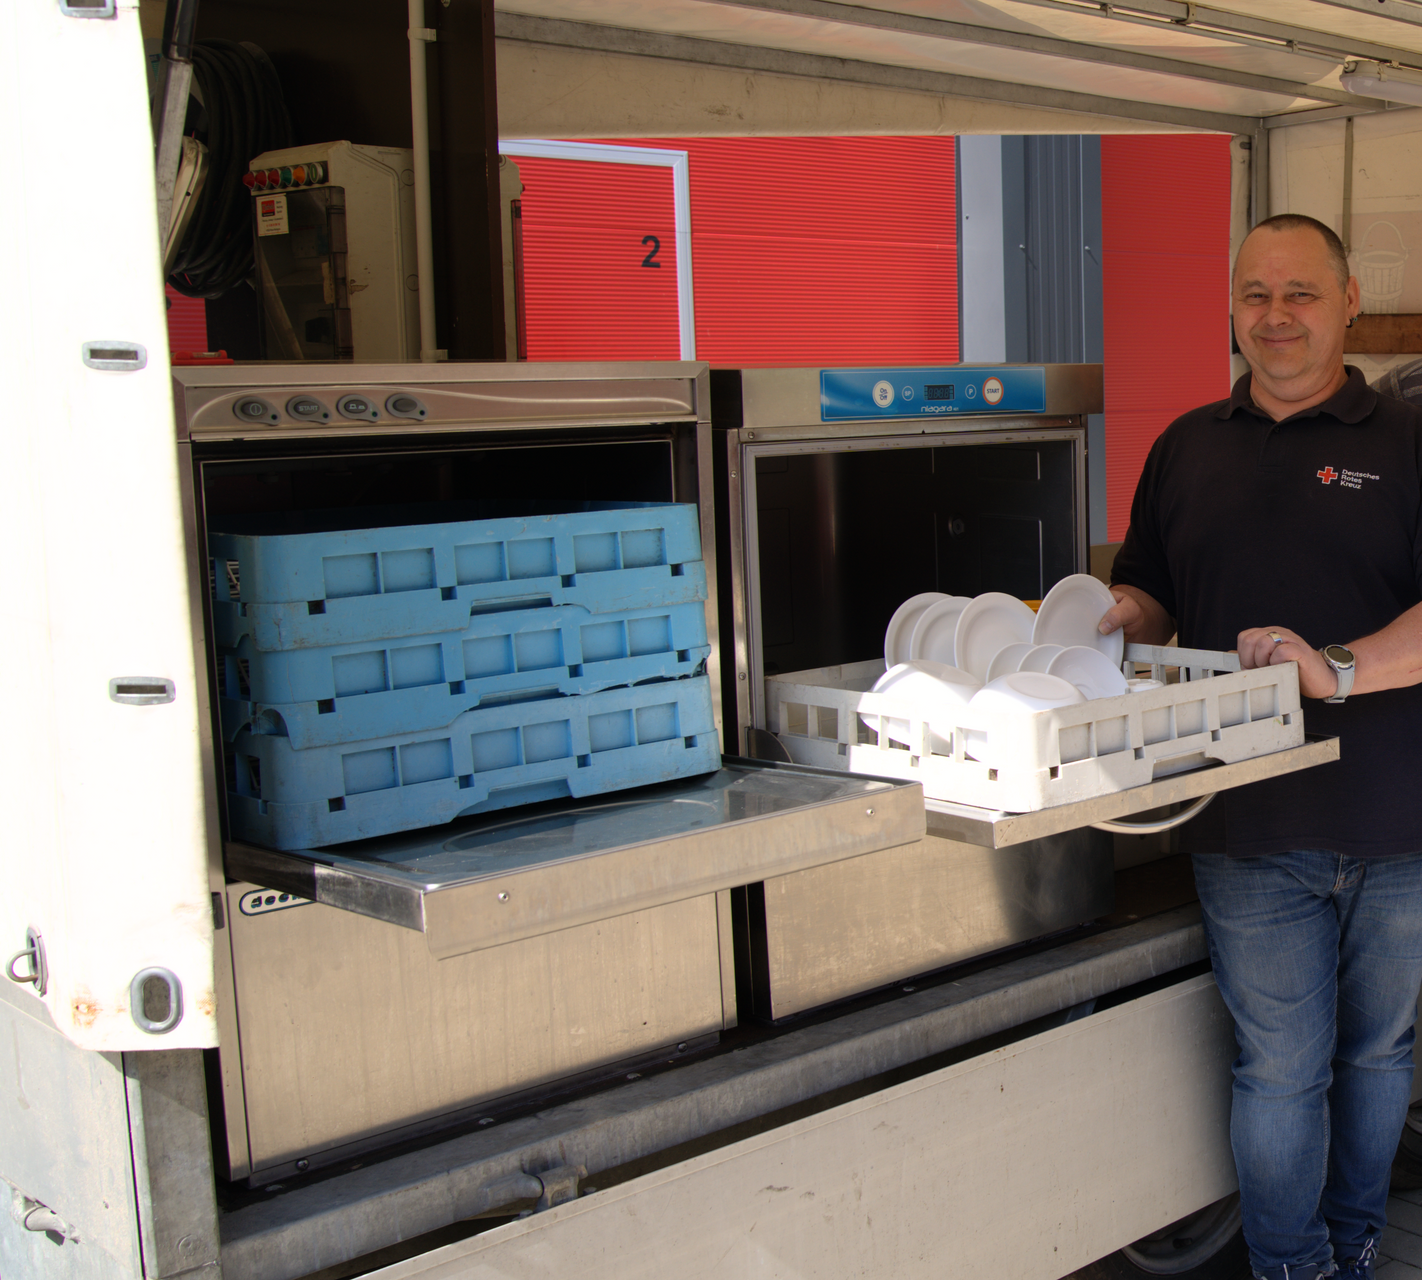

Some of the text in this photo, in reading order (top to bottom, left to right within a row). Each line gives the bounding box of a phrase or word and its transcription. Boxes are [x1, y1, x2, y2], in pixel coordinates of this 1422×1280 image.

[641, 235, 661, 268] 2
[968, 388, 974, 396] P
[920, 405, 953, 413] niagara
[1340, 474, 1363, 484] Rotes
[1342, 469, 1380, 480] Deutsches
[1340, 480, 1362, 489] Kreuz
